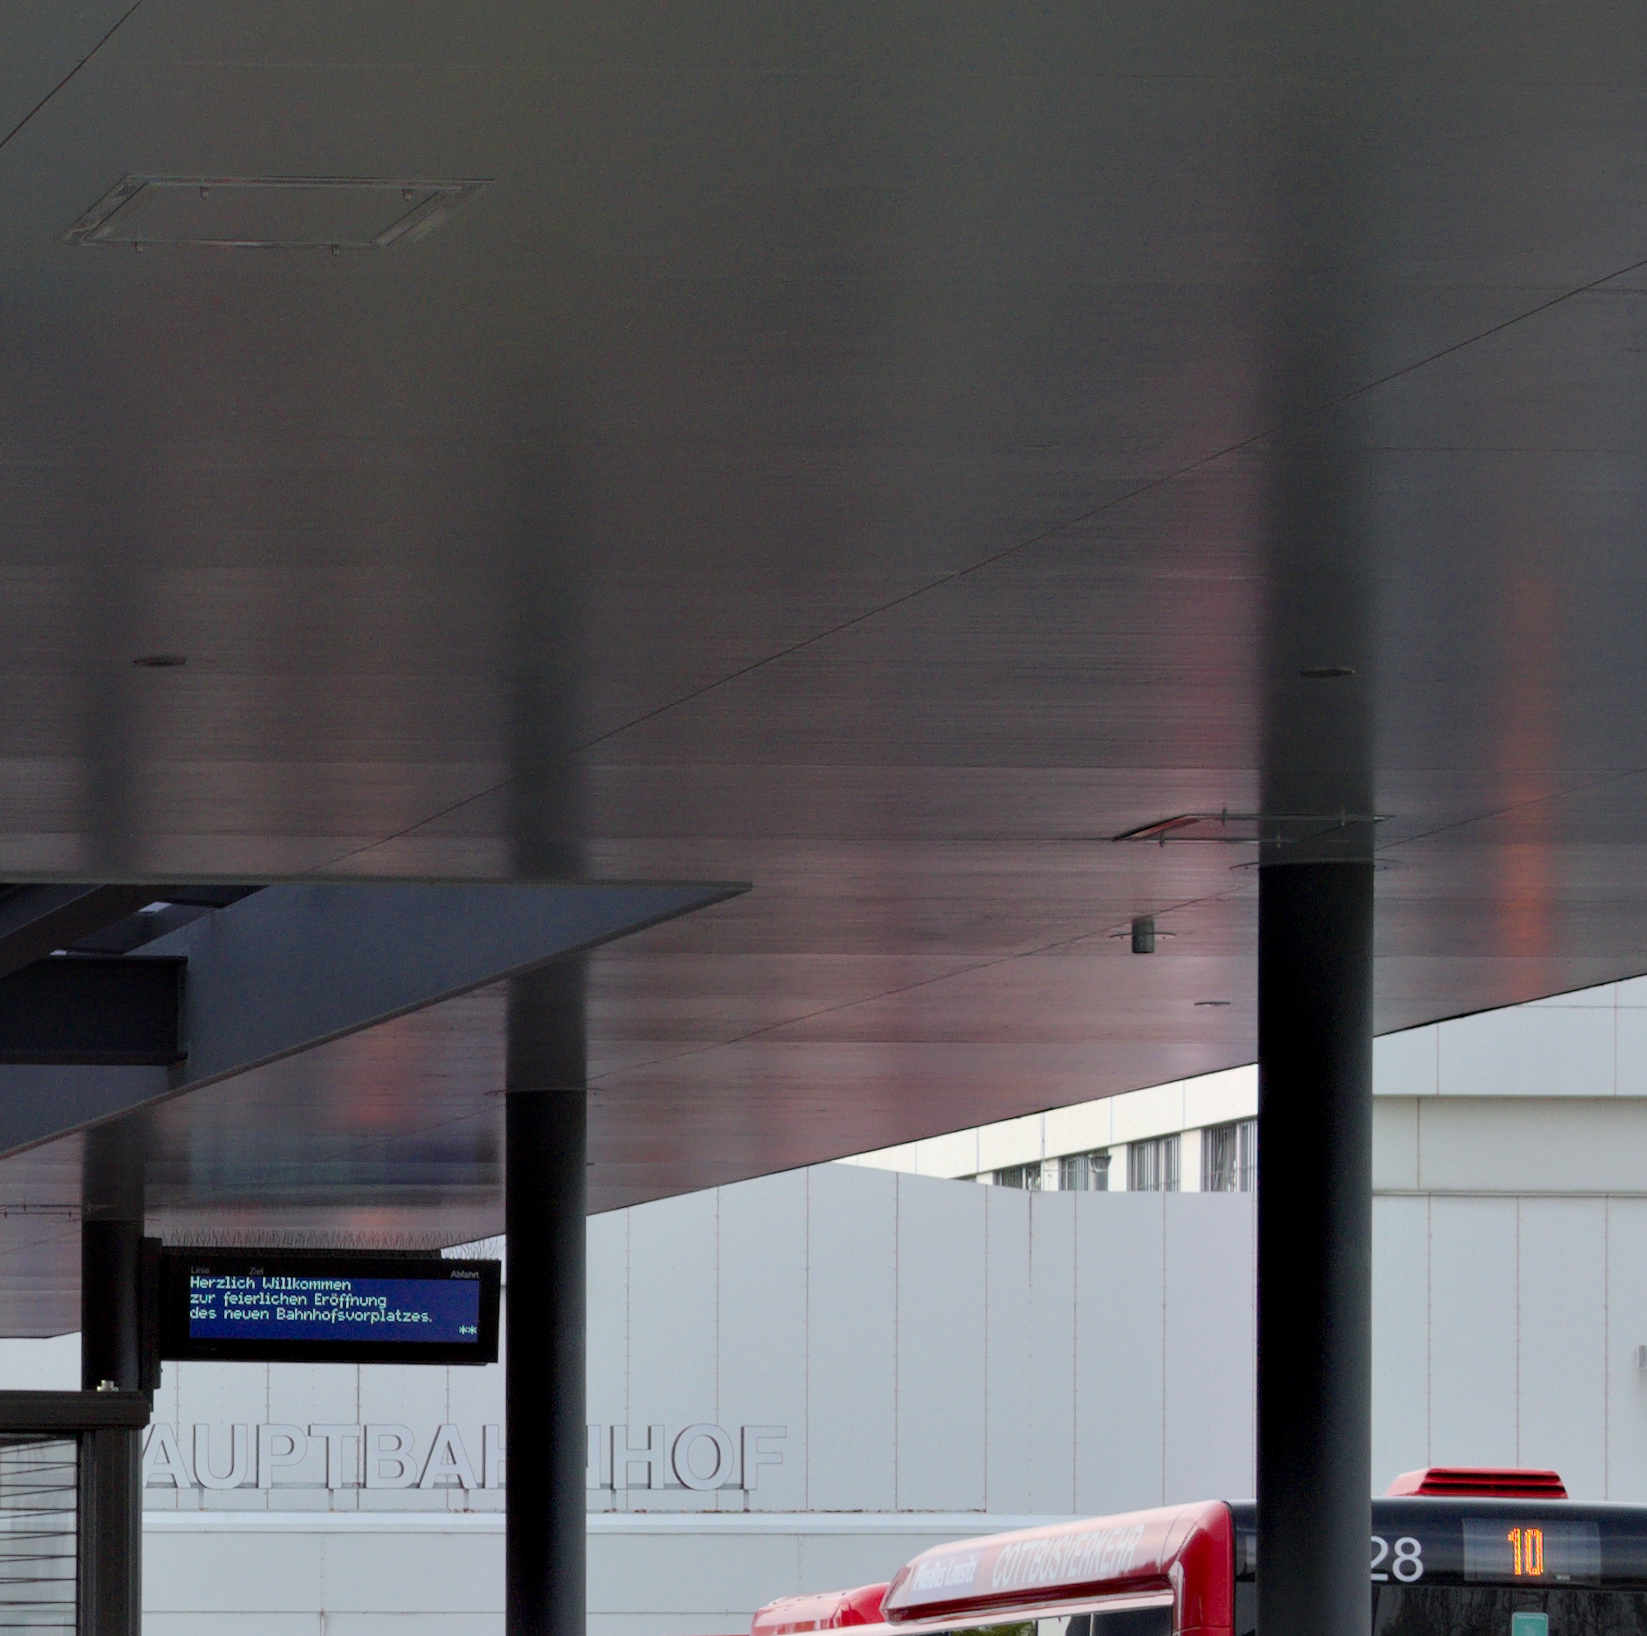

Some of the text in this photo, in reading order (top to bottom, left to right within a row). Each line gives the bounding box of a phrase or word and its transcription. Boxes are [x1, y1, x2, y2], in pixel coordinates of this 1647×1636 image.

[190, 1276, 352, 1291] Herzlich Willkommen
[450, 1269, 480, 1280] Abfahrt
[190, 1291, 387, 1309] zur feierlichen Eröffnung
[190, 1307, 433, 1325] des neuen Bahnhofsvorplatzes.
[991, 1523, 1146, 1589] COTTBUSVERKEHR
[1507, 1527, 1544, 1576] 10
